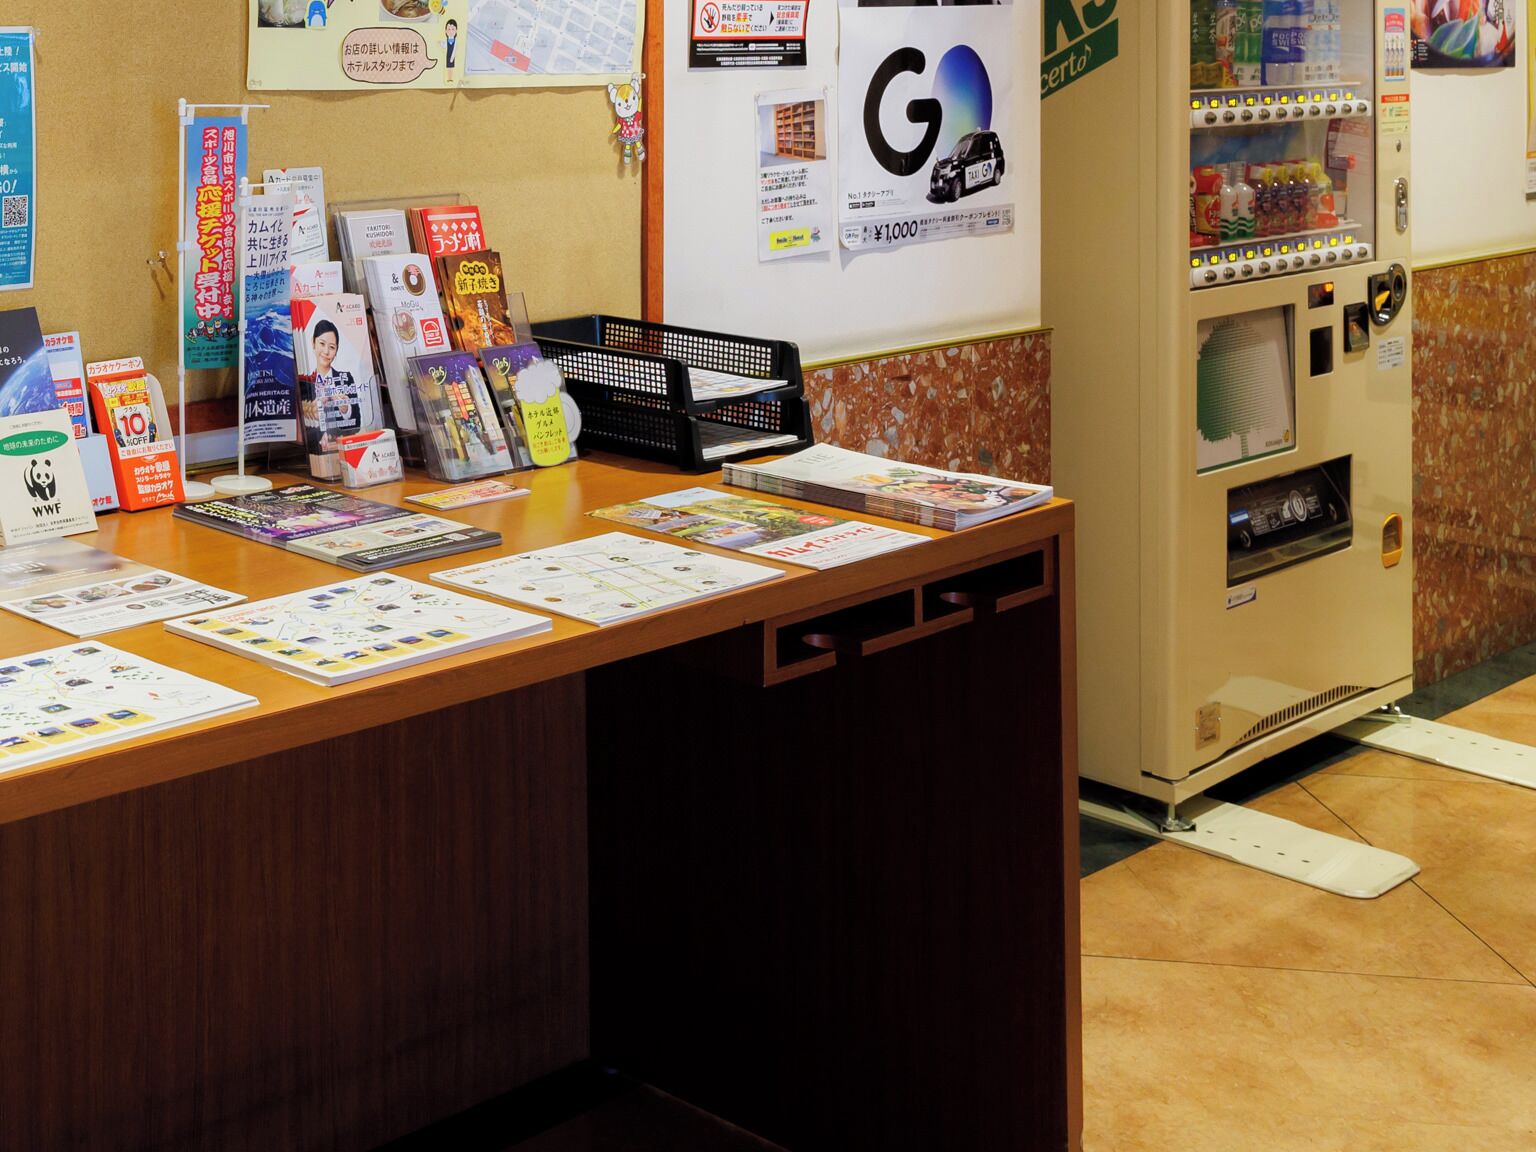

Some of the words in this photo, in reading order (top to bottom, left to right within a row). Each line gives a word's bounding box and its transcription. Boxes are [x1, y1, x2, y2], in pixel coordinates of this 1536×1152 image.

[345, 43, 419, 55] お店の詳しい情報は
[348, 60, 415, 72] ホテルスタッフまで
[968, 168, 979, 181] TAXI
[248, 219, 282, 234] カムイと
[366, 224, 390, 232] YAKITORI
[875, 221, 917, 243] ¥1,000
[247, 233, 288, 250] 共に生きる
[247, 250, 287, 268] 上川アイヌ
[458, 278, 499, 291] 新子焼き
[120, 413, 145, 436] 10
[536, 418, 554, 427] グルメ
[33, 503, 62, 517] WWF
